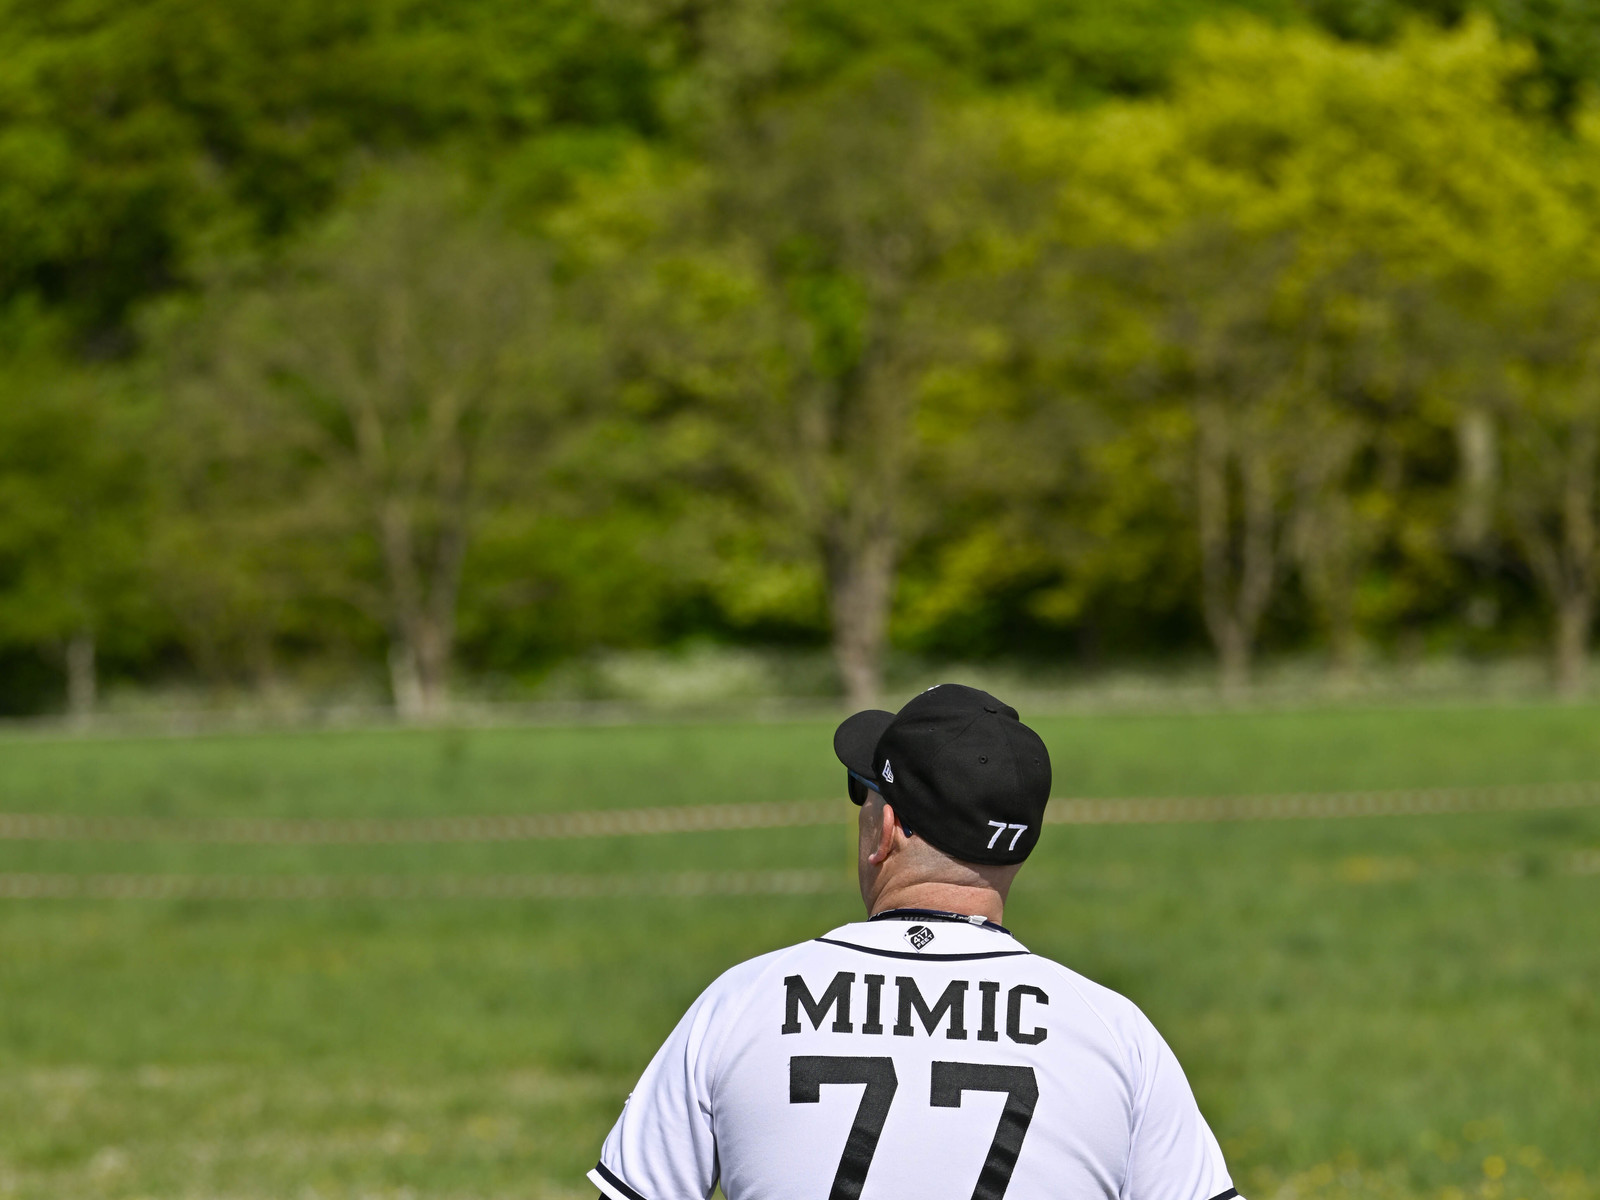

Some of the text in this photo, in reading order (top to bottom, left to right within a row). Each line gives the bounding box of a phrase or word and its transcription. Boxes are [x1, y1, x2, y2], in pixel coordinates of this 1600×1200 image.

[987, 819, 1028, 851] 77
[913, 928, 929, 944] 417
[781, 971, 1049, 1045] MIMIC
